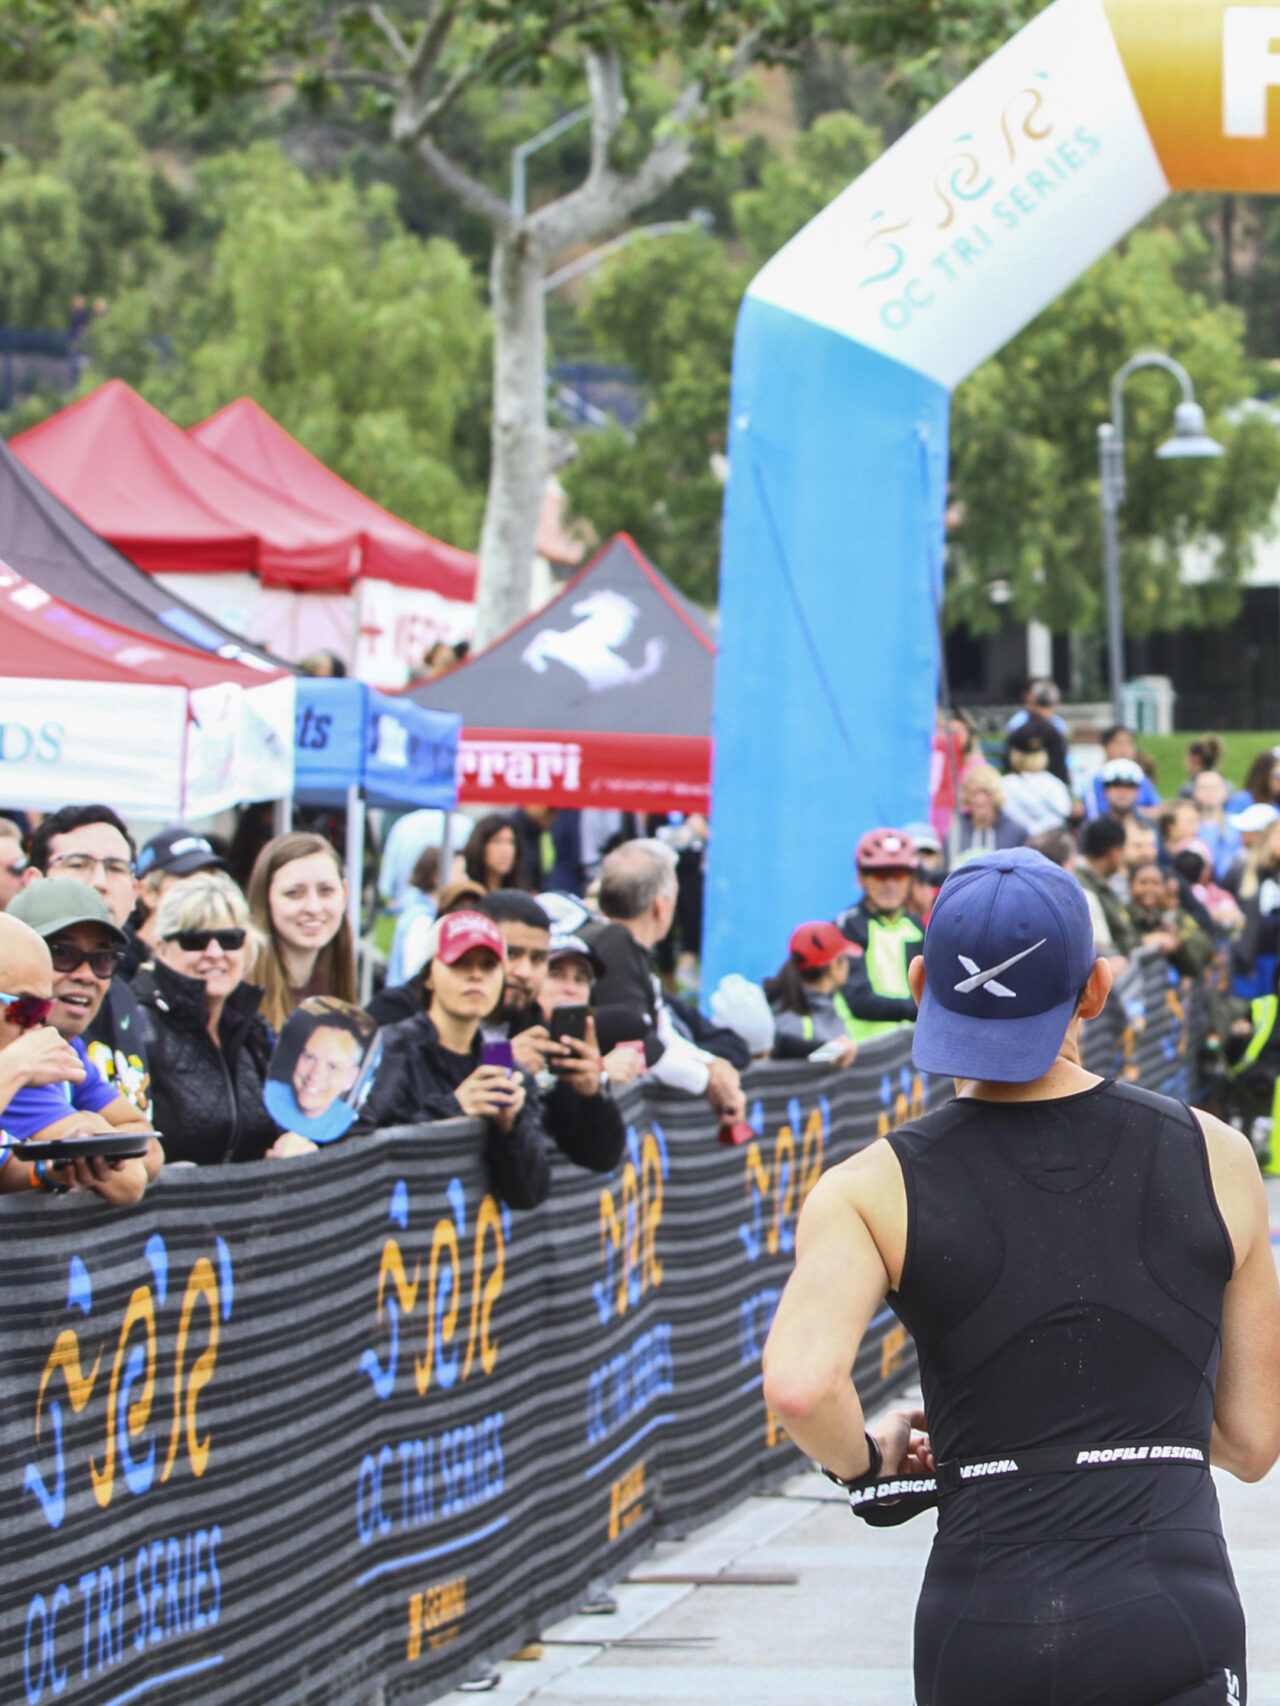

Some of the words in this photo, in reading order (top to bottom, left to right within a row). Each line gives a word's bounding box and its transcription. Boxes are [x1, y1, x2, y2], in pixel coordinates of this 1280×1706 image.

[879, 277, 935, 331] OC
[930, 224, 994, 280] TRI
[991, 125, 1102, 230] SERIES
[295, 706, 333, 749] ts
[356, 1443, 394, 1545] OC
[397, 1436, 434, 1530] TRI
[439, 1411, 505, 1517] SERIES
[876, 1479, 937, 1498] DESIGN
[1076, 1446, 1150, 1464] PROFILE
[1149, 1445, 1200, 1460] DESIGN
[23, 1582, 71, 1705] OC
[78, 1556, 125, 1681] TRI
[133, 1524, 223, 1651] SERIES
